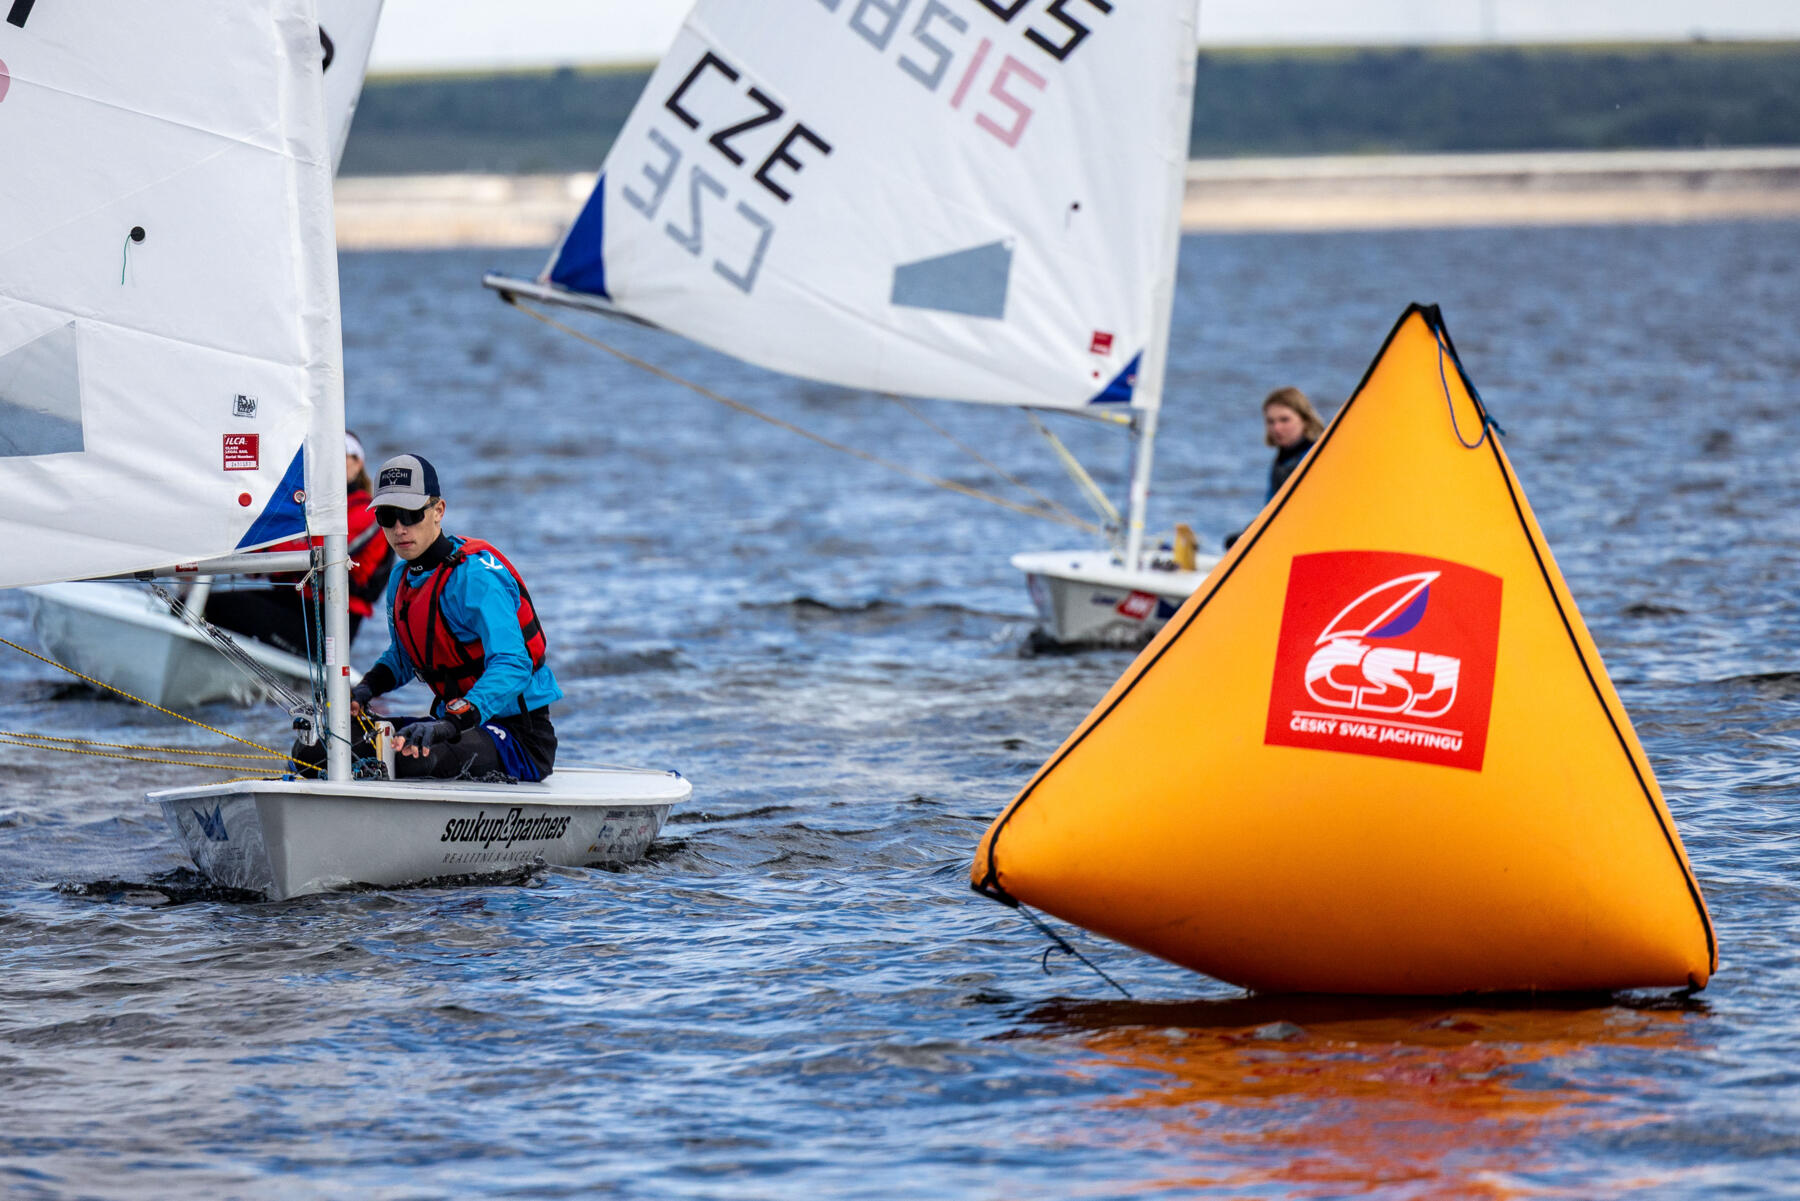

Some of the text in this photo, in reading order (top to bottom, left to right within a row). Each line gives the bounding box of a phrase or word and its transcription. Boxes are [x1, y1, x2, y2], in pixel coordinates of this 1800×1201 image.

[665, 51, 832, 203] CZE
[226, 437, 246, 445] ILCA
[1290, 716, 1463, 752] ČESKÝ SVAZ JACHTINGU
